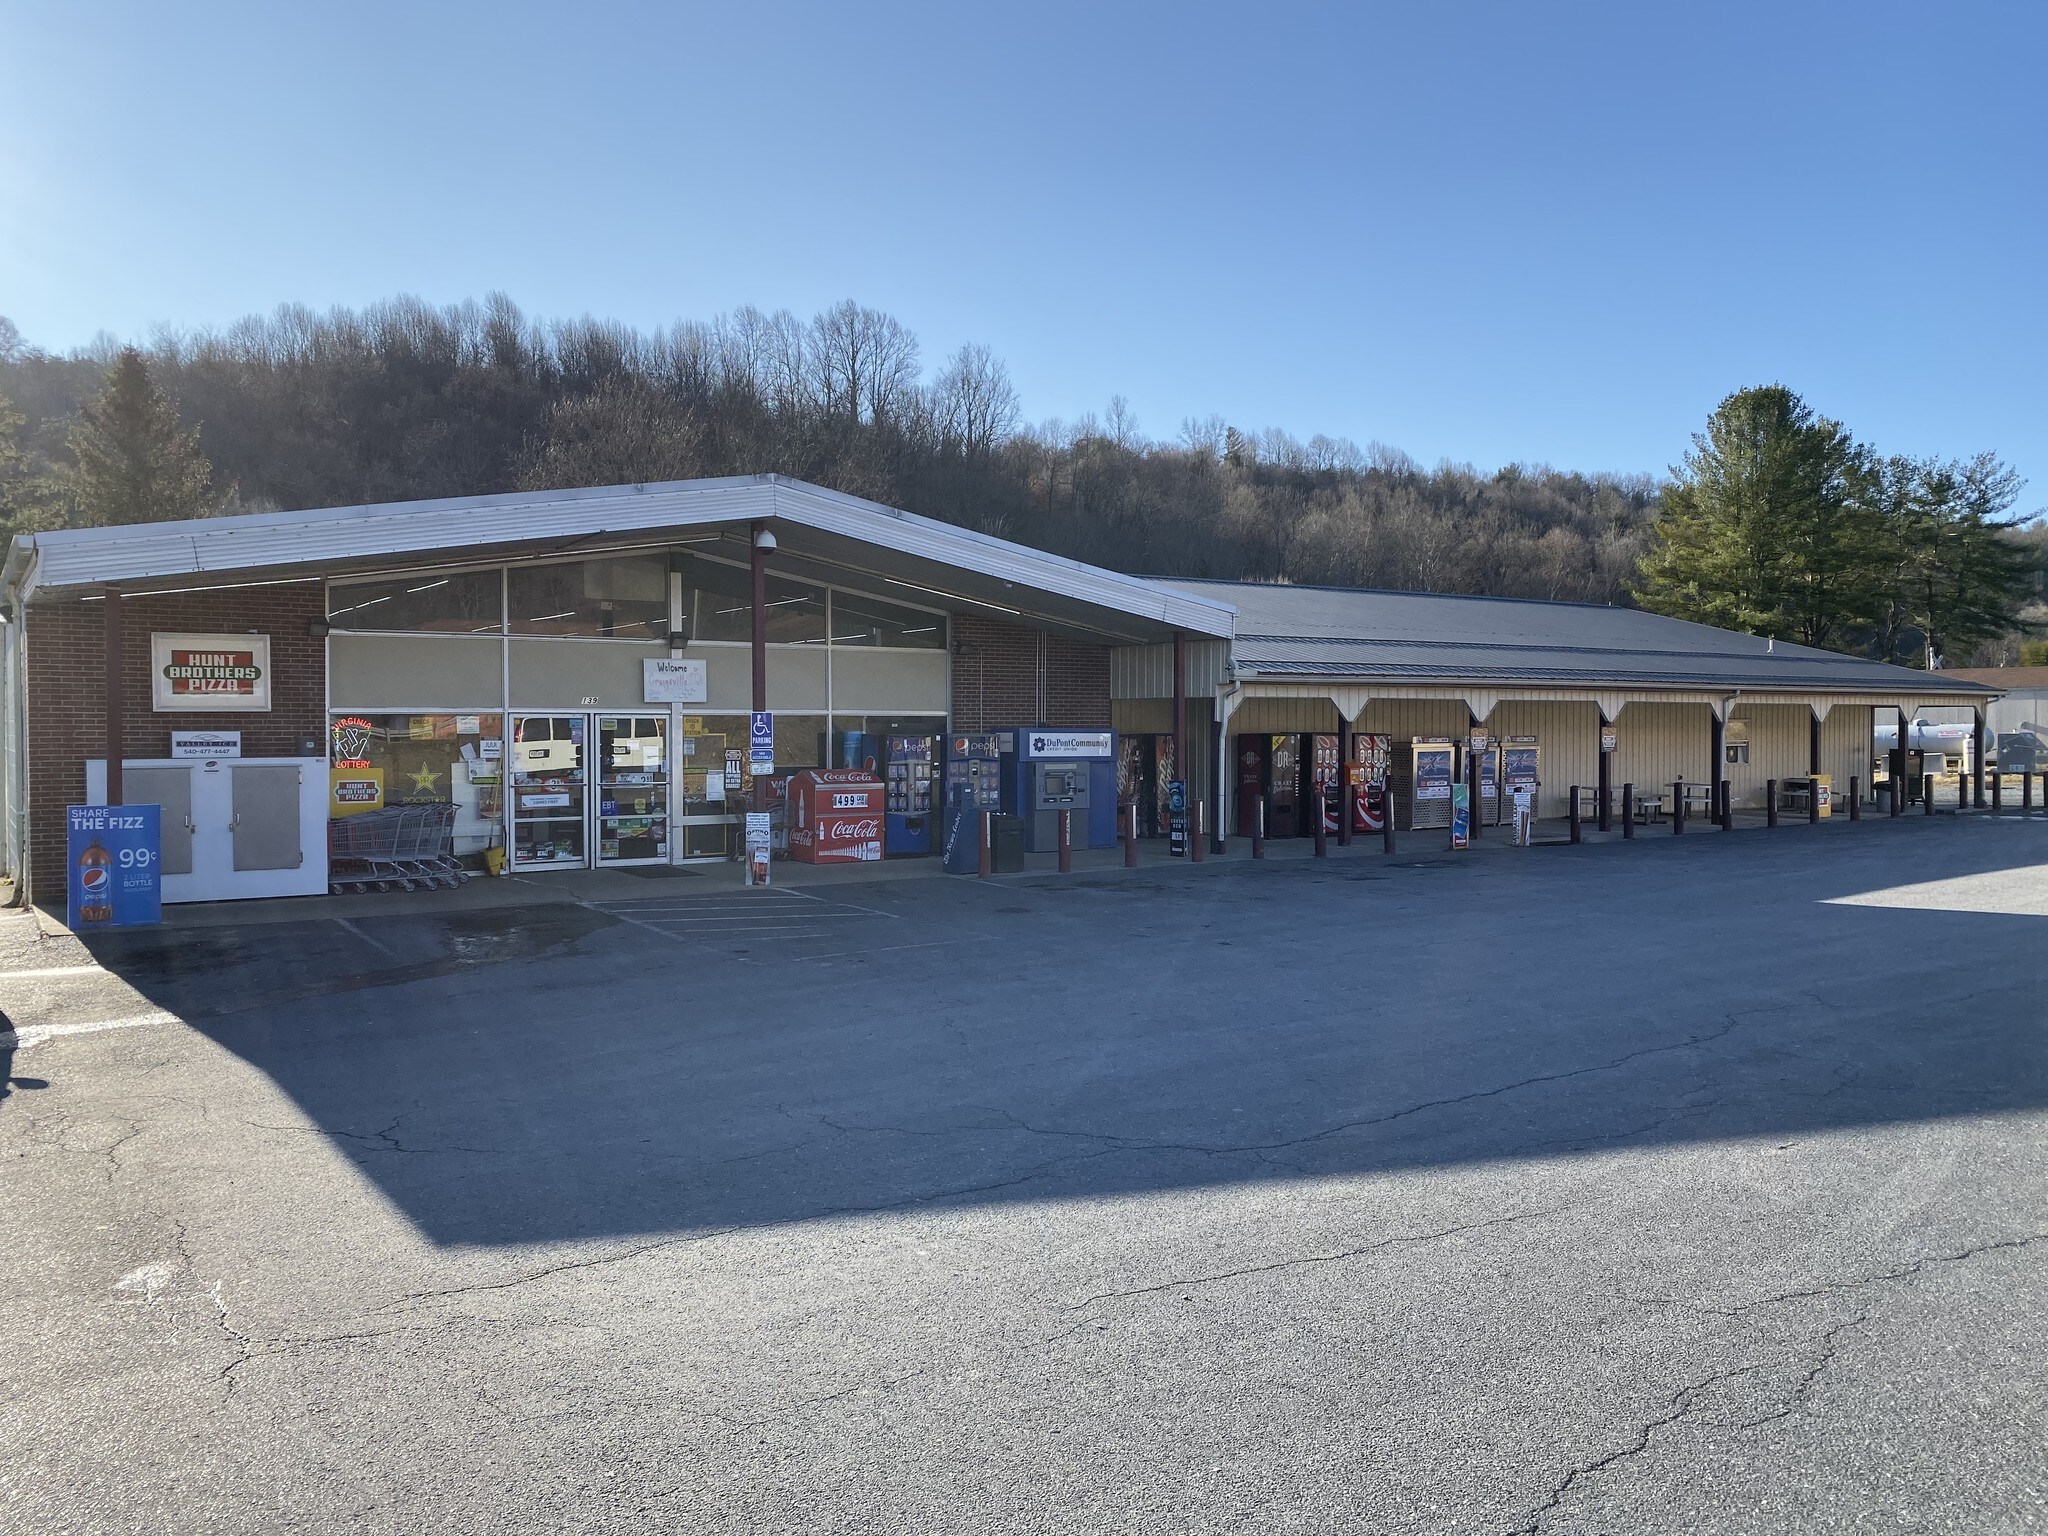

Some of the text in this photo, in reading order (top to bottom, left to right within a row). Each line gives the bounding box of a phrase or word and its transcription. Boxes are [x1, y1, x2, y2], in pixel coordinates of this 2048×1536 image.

[188, 655, 237, 666] HUNT
[169, 667, 256, 678] BROTHERS
[656, 661, 688, 673] Welcome
[188, 679, 239, 691] PIZZA
[332, 717, 372, 731] VIRGINIA
[752, 736, 772, 744] PARKING
[336, 760, 371, 769] LOTTERY
[726, 760, 741, 773] ALL
[602, 801, 616, 809] EBT
[71, 809, 110, 818] SHARE
[71, 817, 144, 831] THE FIZZ
[123, 879, 153, 888] BOTTLE
